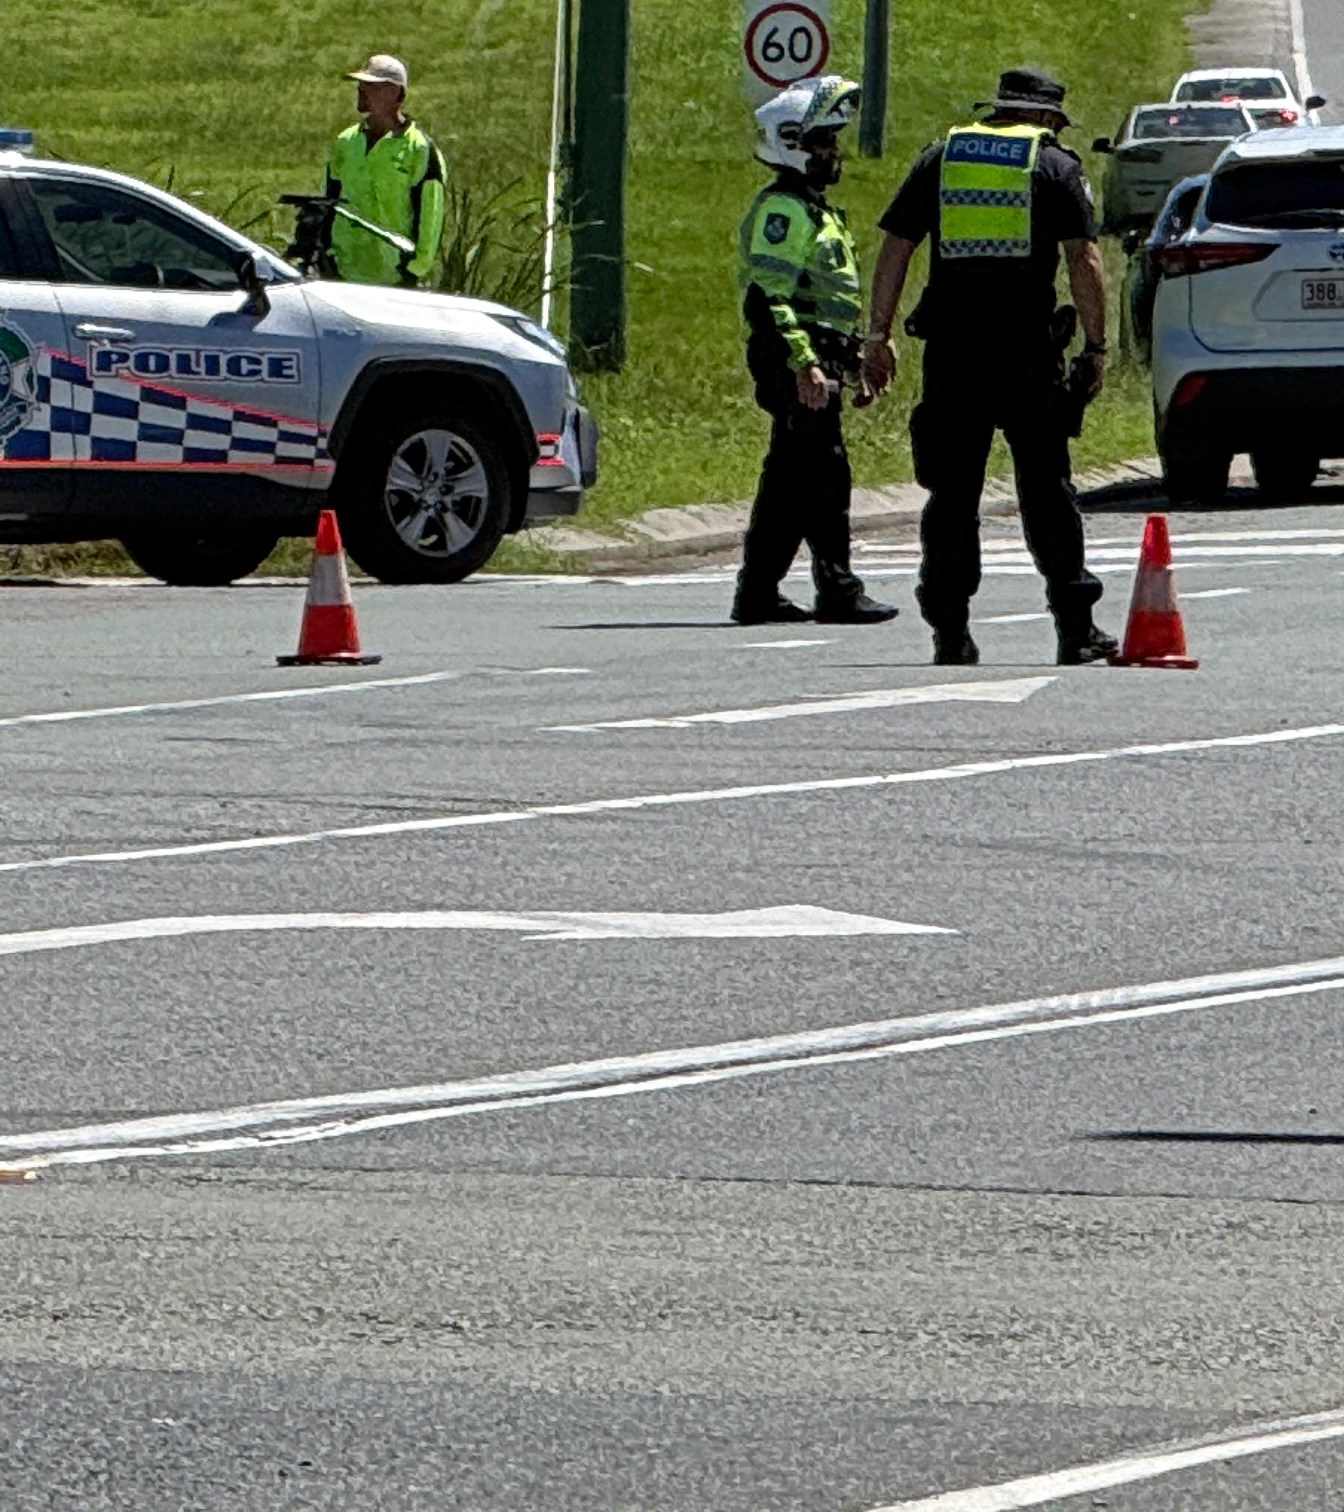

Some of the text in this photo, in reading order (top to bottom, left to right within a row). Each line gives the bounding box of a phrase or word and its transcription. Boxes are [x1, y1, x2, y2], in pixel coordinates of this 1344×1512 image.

[761, 25, 813, 63] 60
[953, 138, 1024, 160] POLICE
[92, 347, 298, 380] POLICE
